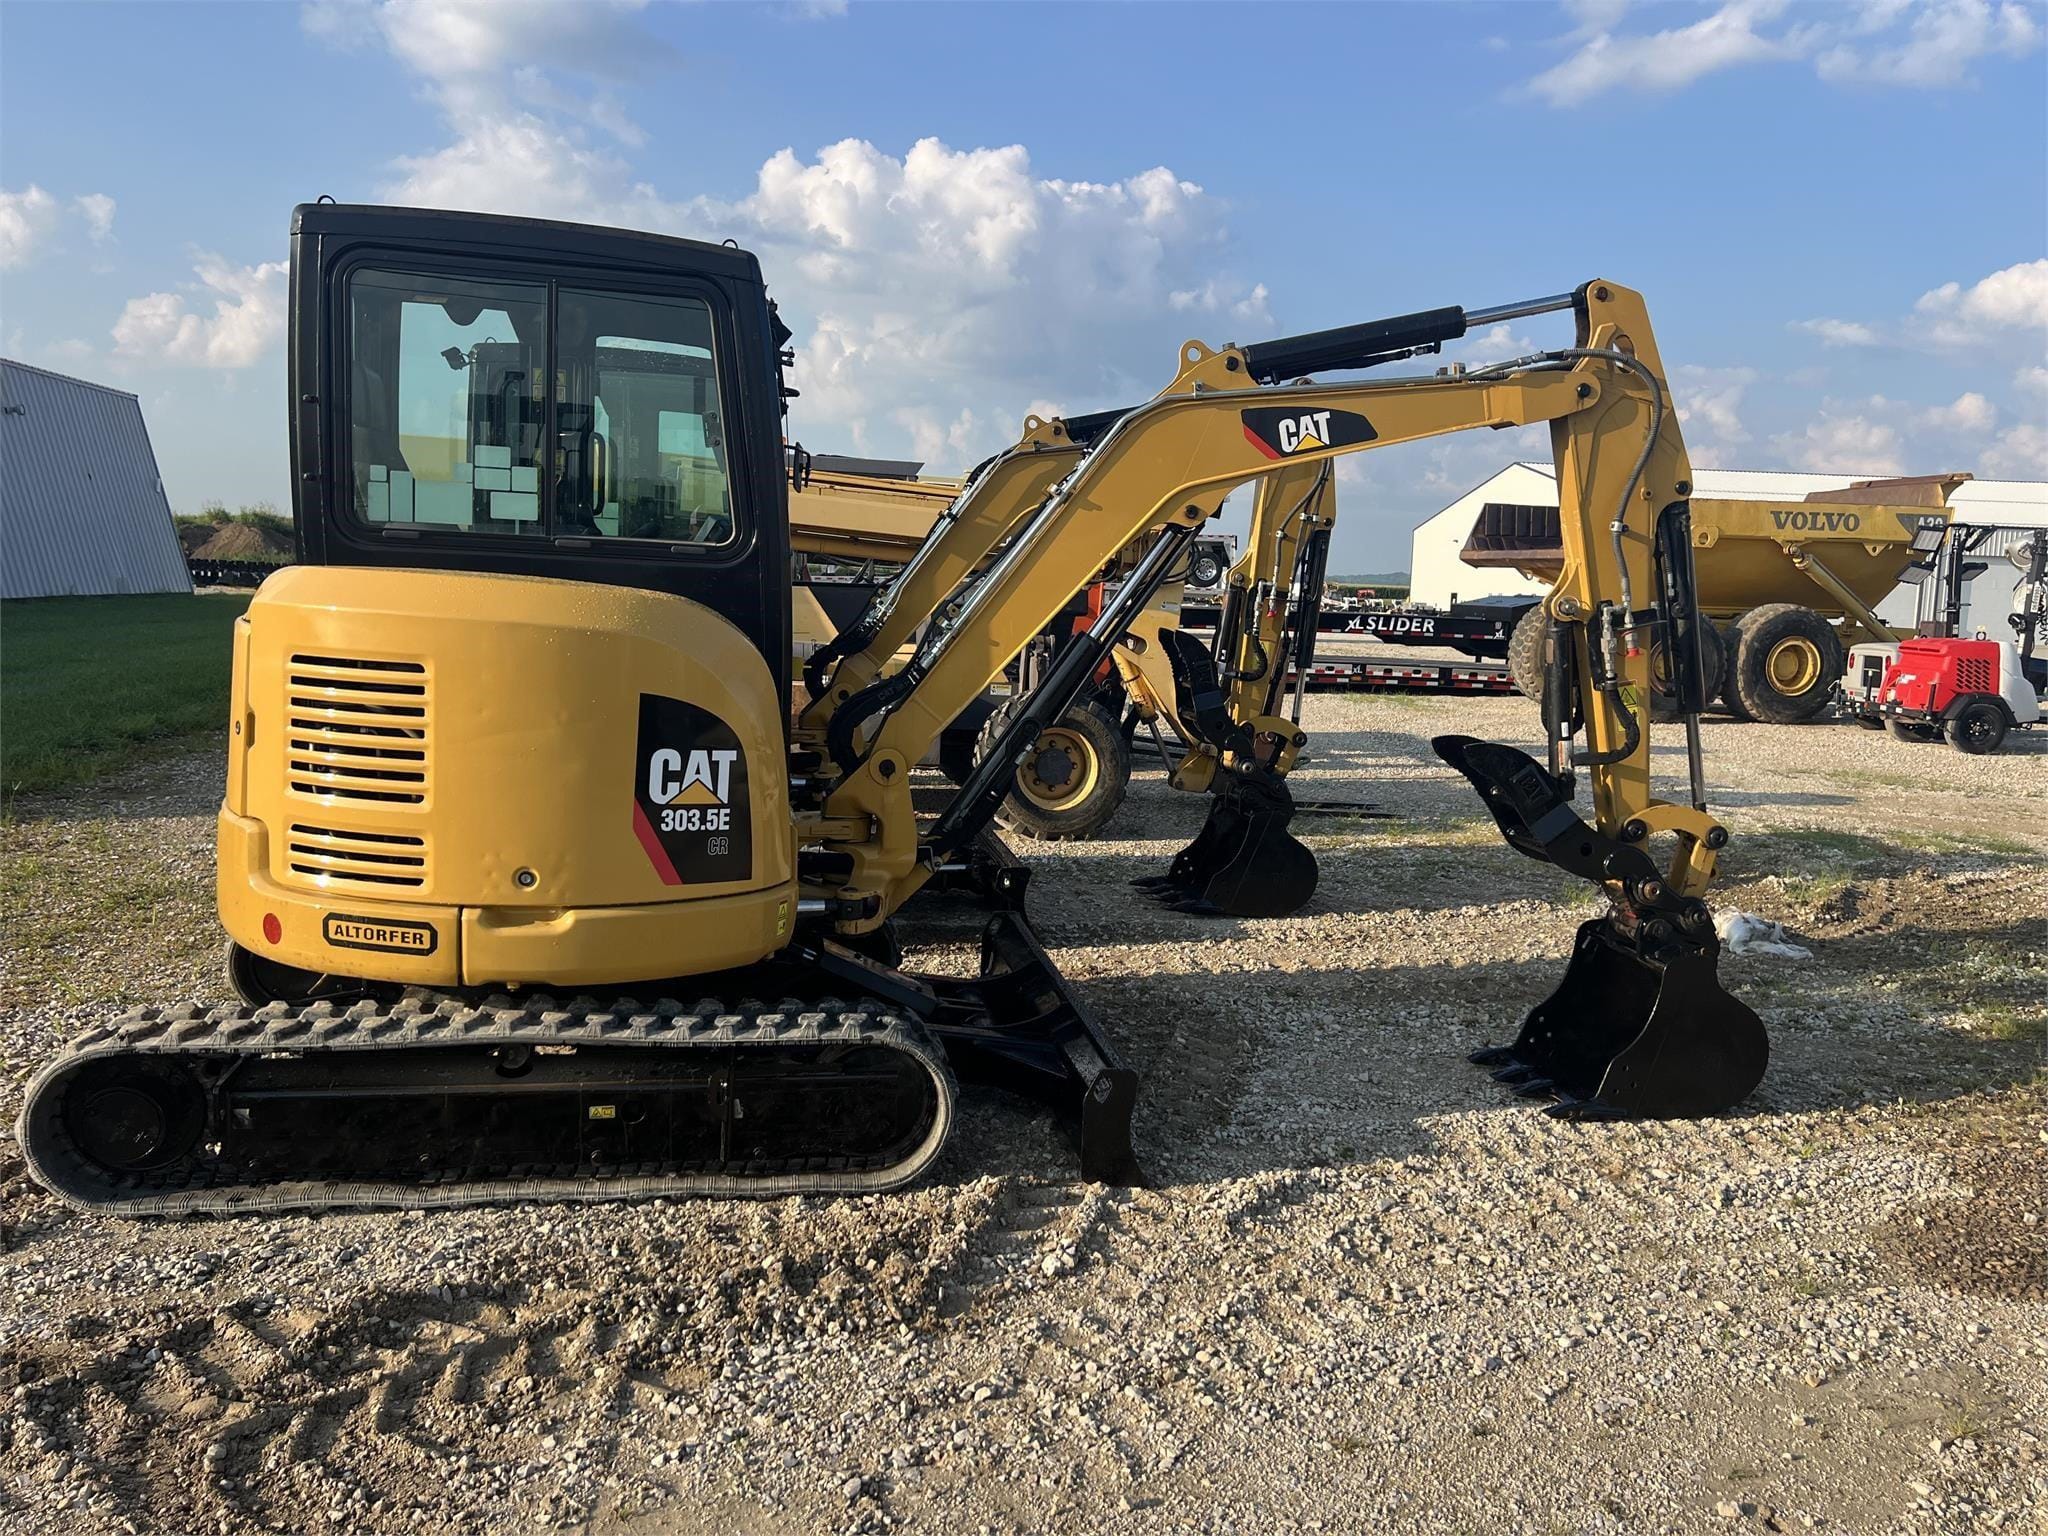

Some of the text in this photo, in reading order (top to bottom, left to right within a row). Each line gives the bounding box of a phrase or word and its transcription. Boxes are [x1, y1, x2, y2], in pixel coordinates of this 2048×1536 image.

[1279, 411, 1330, 453] CAT
[1770, 511, 1860, 532] VOLVO
[1365, 616, 1435, 632] SLIDER
[649, 748, 737, 805] CAT
[661, 808, 730, 831] 303.5E
[707, 837, 728, 855] CR
[334, 925, 424, 945] ALTORFER
